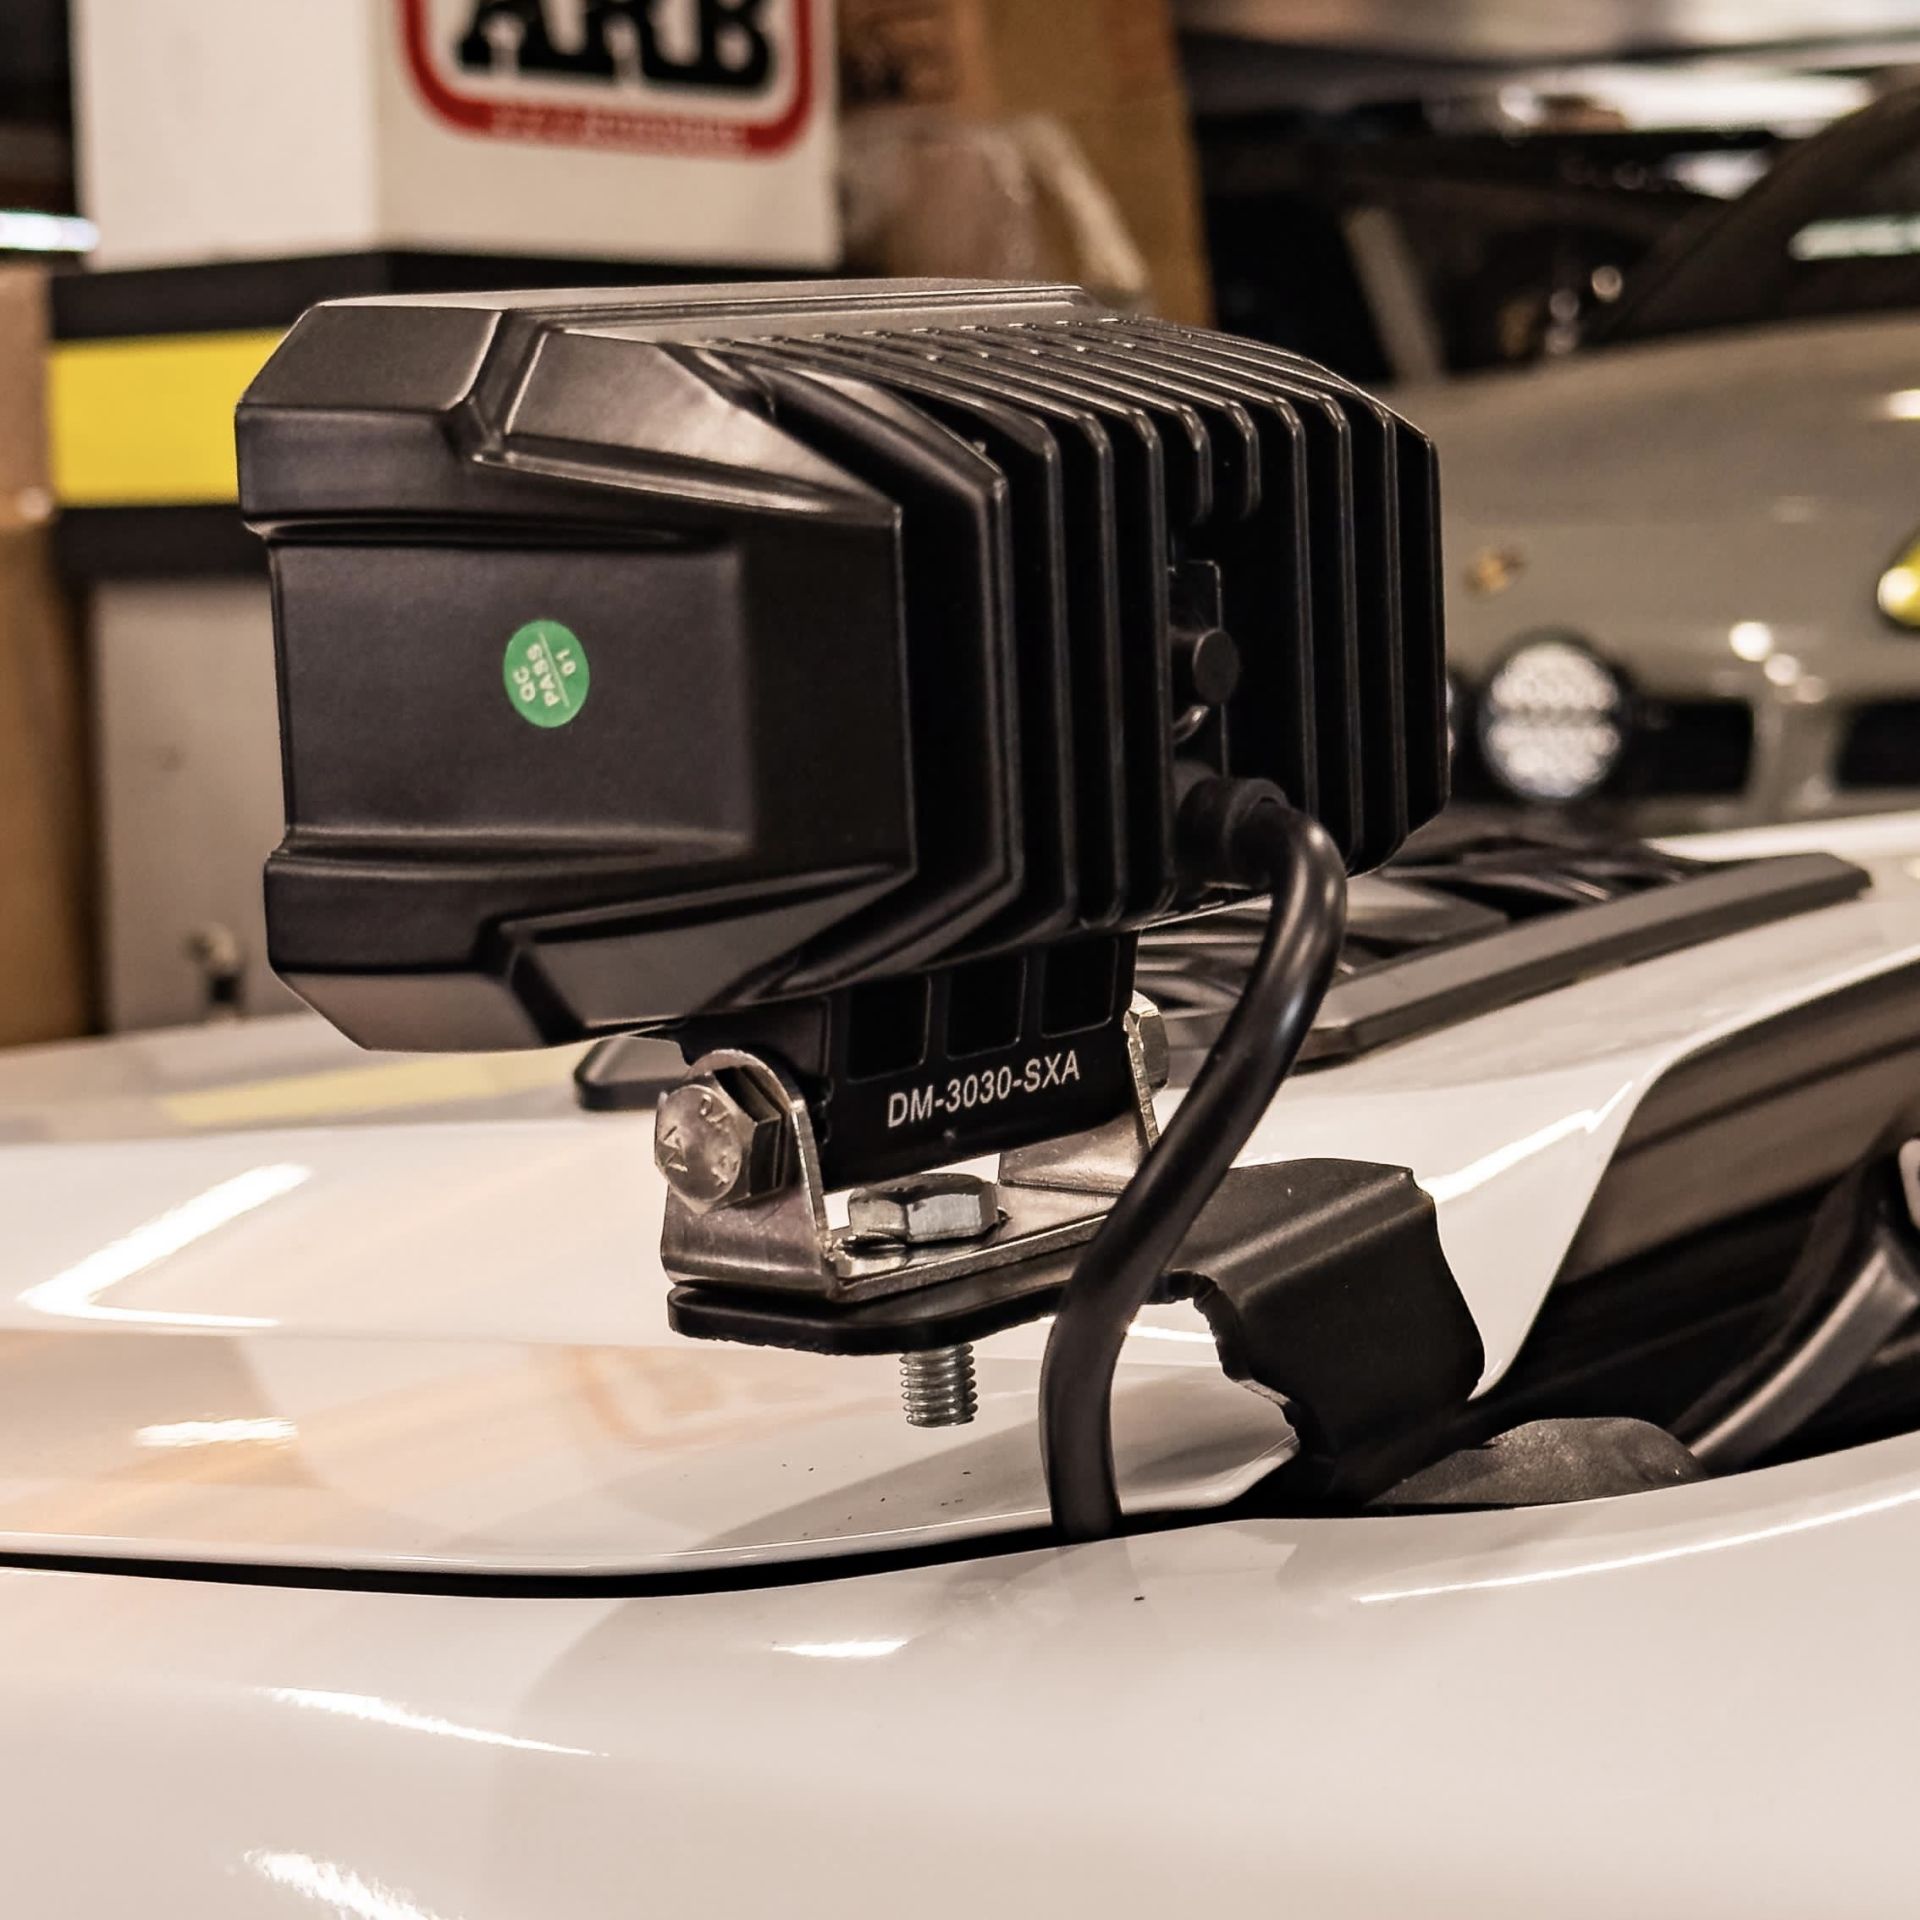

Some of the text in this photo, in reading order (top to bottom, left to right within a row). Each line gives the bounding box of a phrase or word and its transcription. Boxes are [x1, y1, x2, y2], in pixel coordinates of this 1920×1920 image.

[512, 666, 536, 703] QC
[526, 644, 560, 707] PASS
[888, 1050, 1080, 1128] DM-3030-SXA
